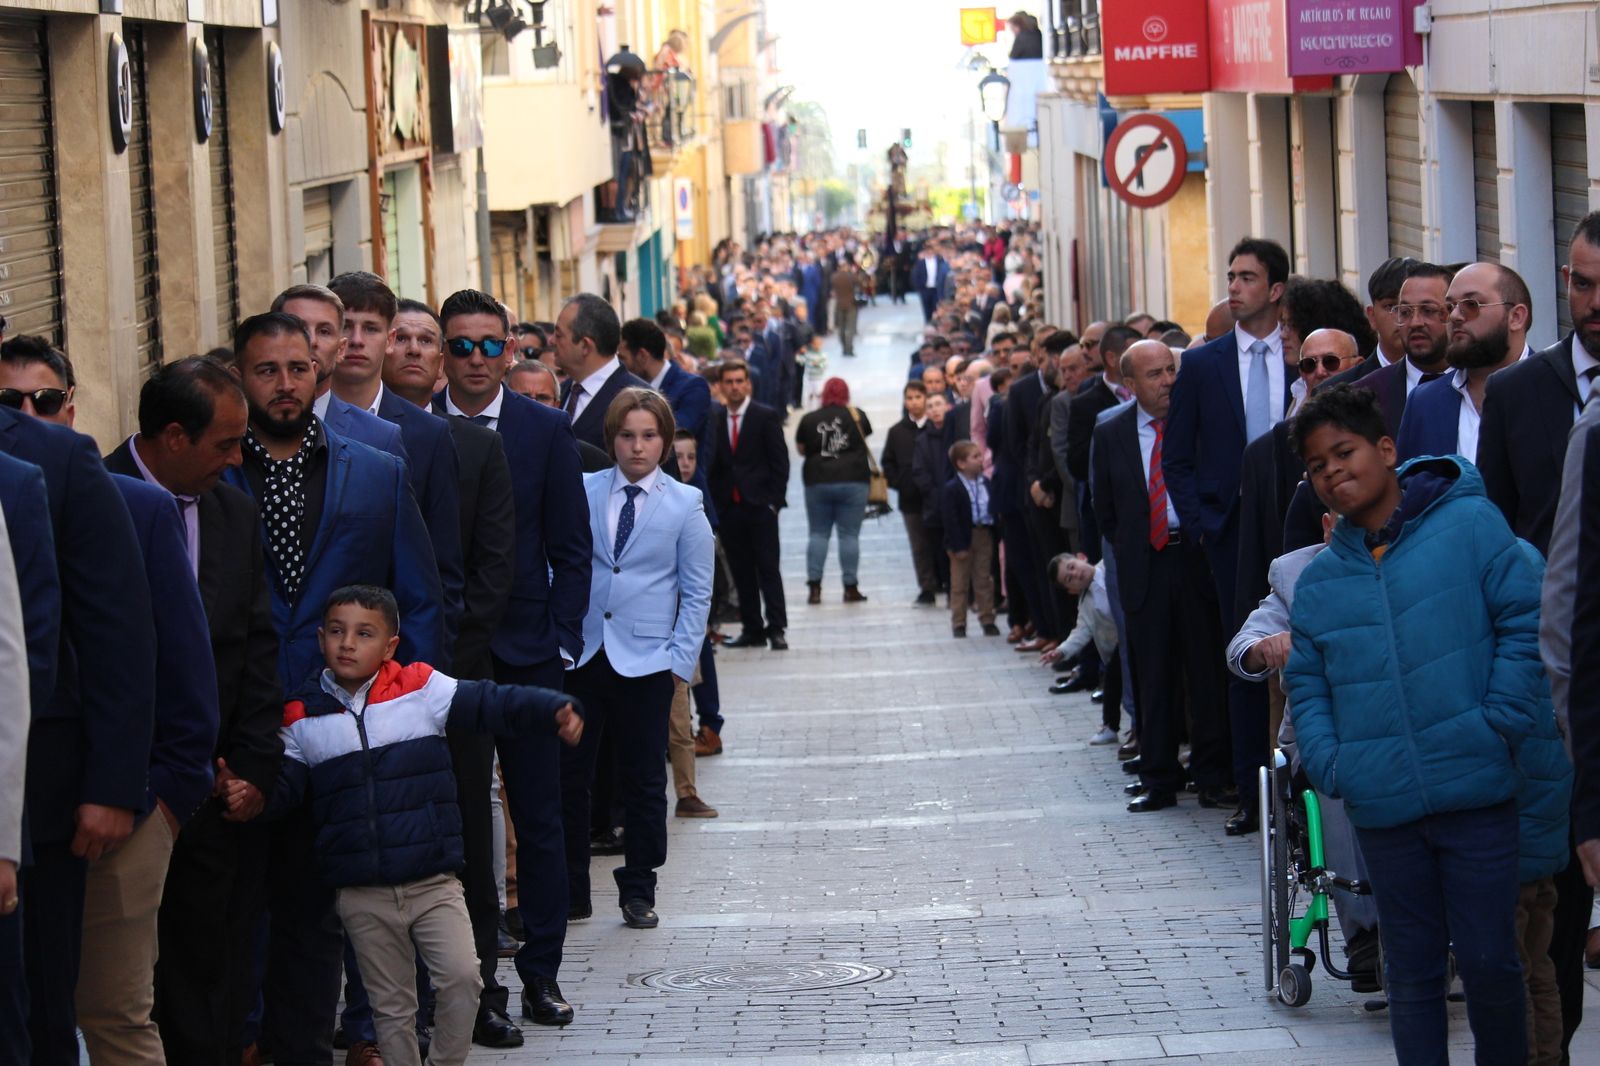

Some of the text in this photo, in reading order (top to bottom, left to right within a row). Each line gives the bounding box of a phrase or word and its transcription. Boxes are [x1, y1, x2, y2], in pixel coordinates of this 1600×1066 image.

[1300, 7, 1391, 23] ARTÍCULOS DE REGALO
[1232, 3, 1273, 64] MAPFRE
[1300, 33, 1392, 51] MULTIPRECIO
[1114, 43, 1198, 61] MAPFRE
